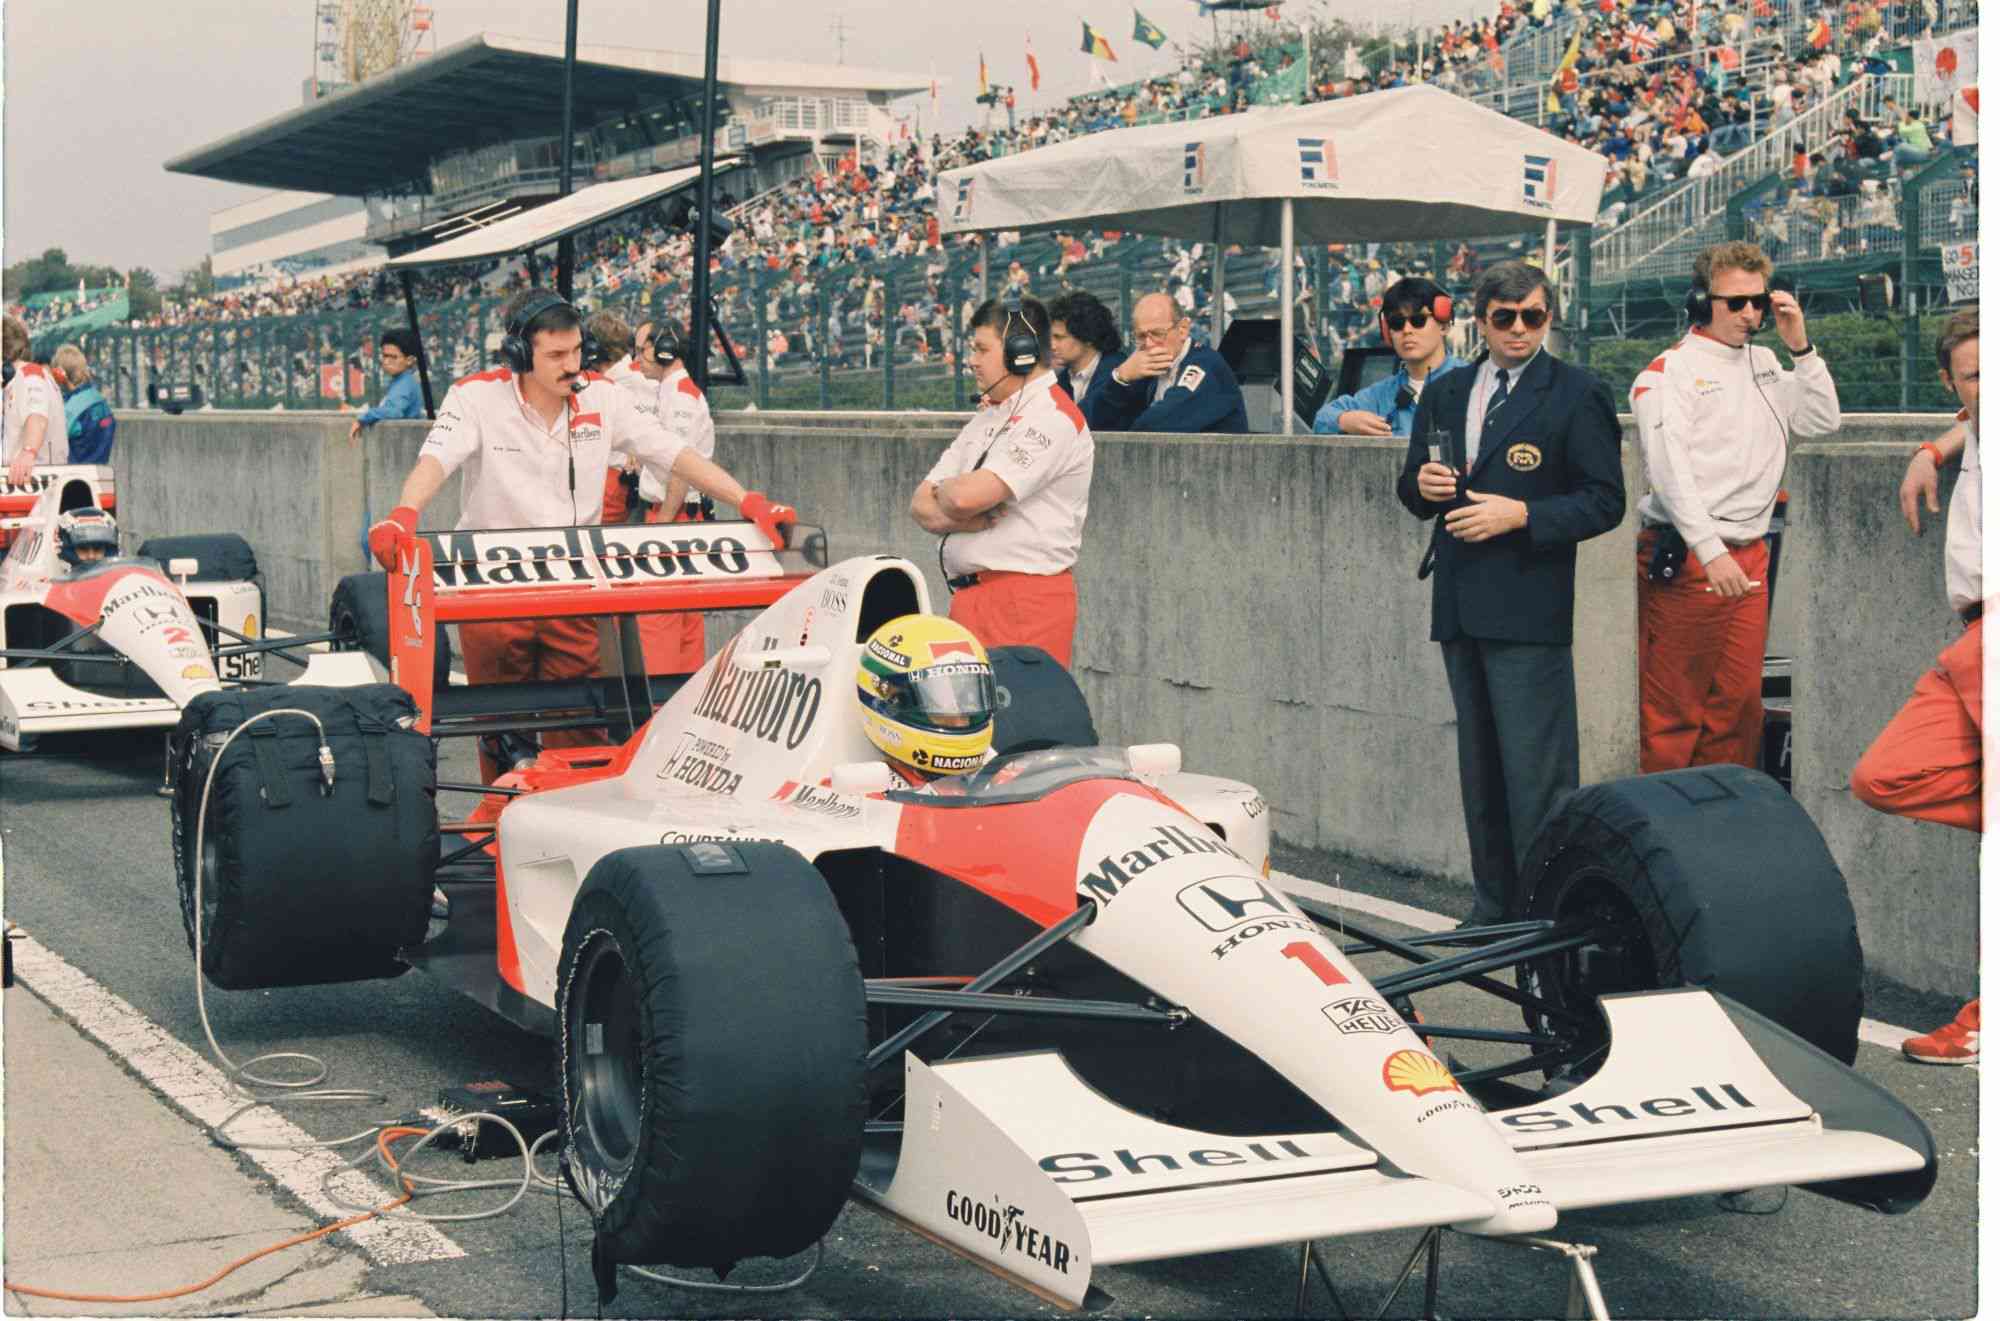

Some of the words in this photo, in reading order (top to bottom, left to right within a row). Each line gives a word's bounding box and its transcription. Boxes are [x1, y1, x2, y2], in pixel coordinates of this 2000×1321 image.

[1961, 247, 1972, 267] 5
[432, 528, 749, 589] Marlboro
[162, 626, 192, 645] 2
[693, 633, 821, 750] Marlboro
[674, 755, 743, 796] HONDA
[793, 784, 860, 817] Marlboro
[1280, 941, 1351, 986] 1
[1334, 1000, 1386, 1016] TAG
[1501, 1083, 1756, 1133] Shell
[1038, 1140, 1311, 1184] Shell
